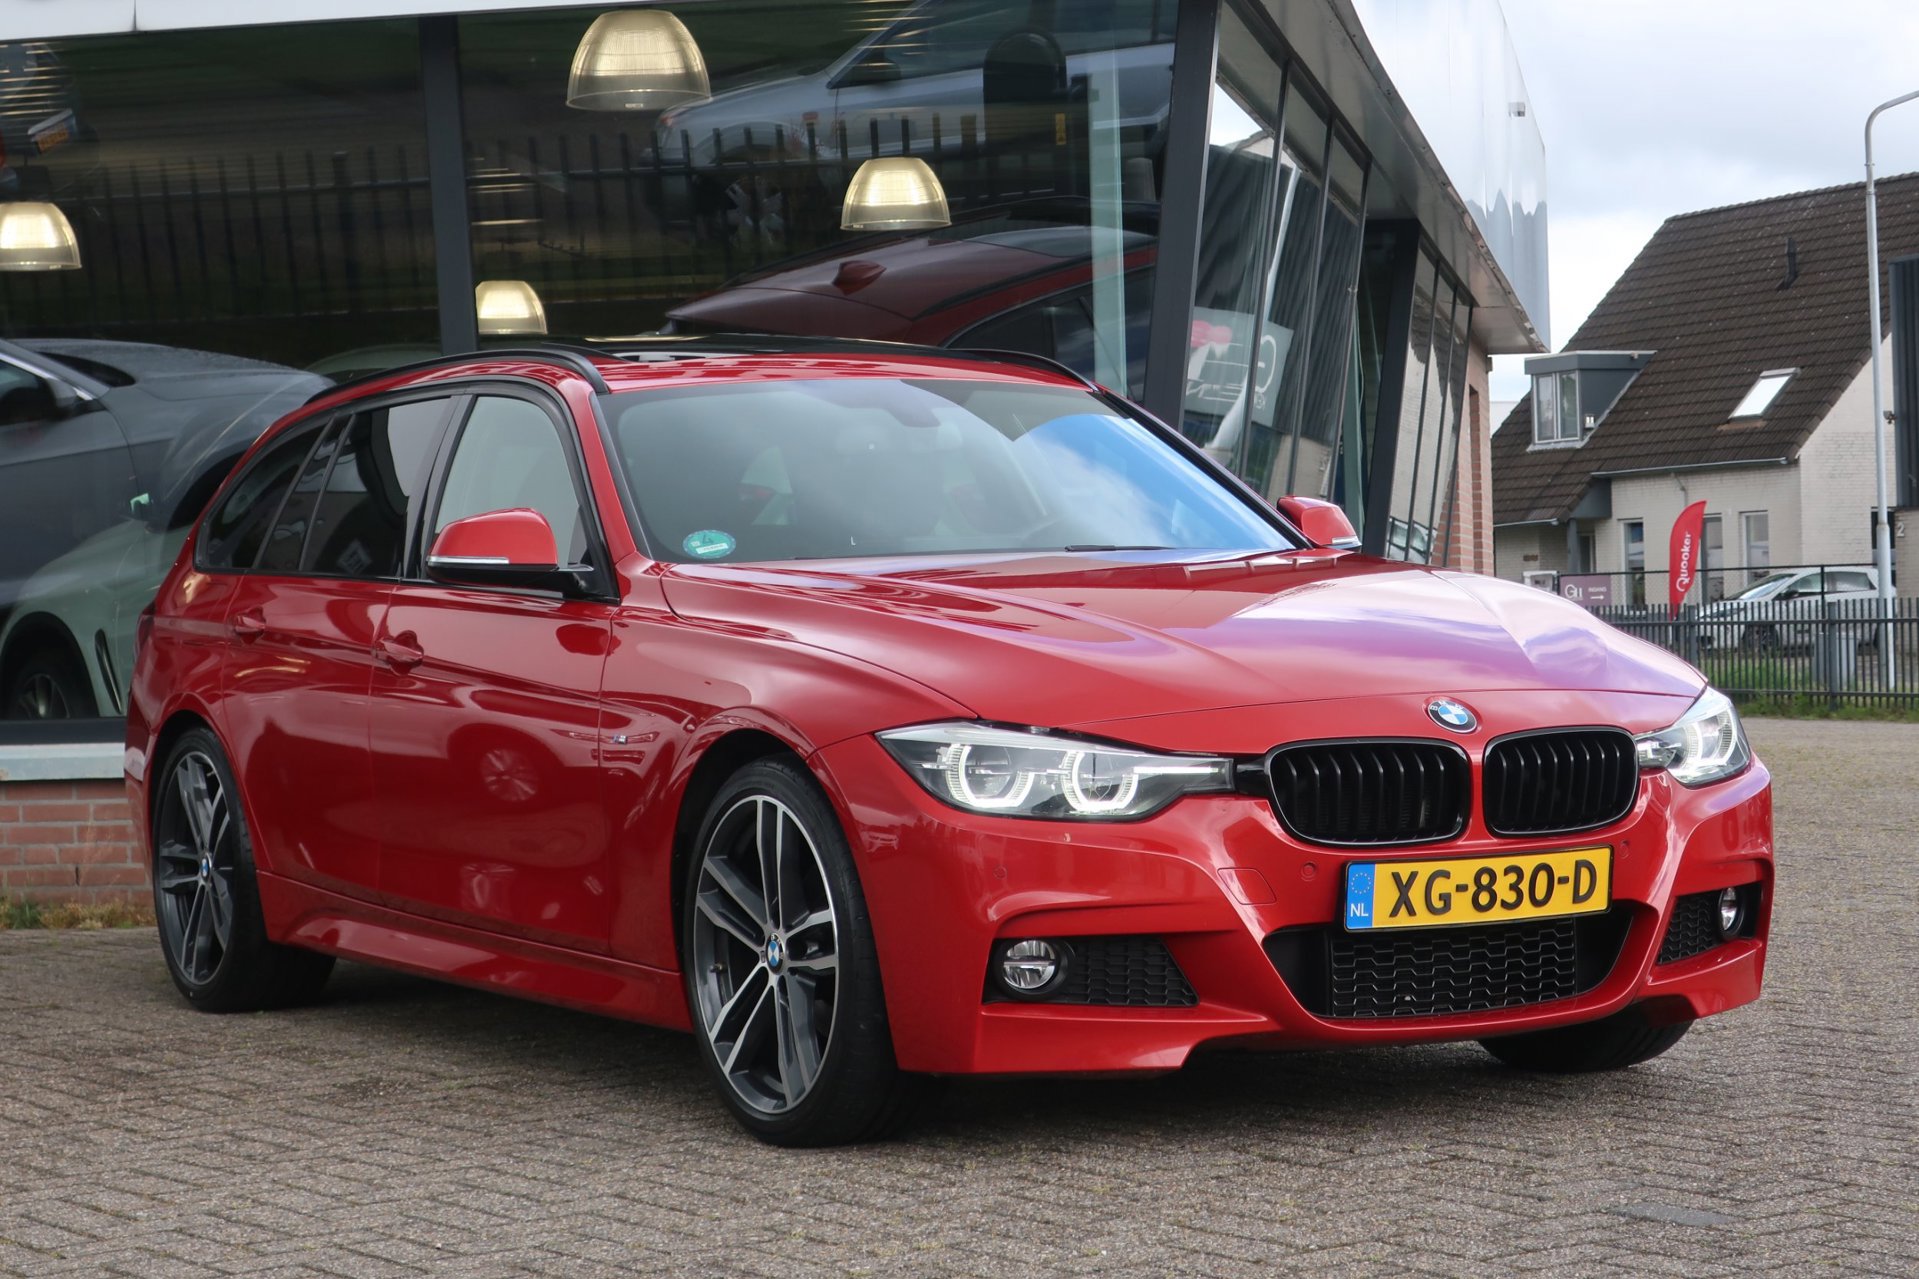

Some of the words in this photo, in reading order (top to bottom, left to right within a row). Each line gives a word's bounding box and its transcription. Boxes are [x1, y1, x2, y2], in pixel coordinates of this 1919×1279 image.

[1897, 522, 1905, 537] 2
[1676, 532, 1692, 592] Quooker
[1389, 859, 1598, 918] XG-830-D
[1350, 903, 1369, 917] NL
